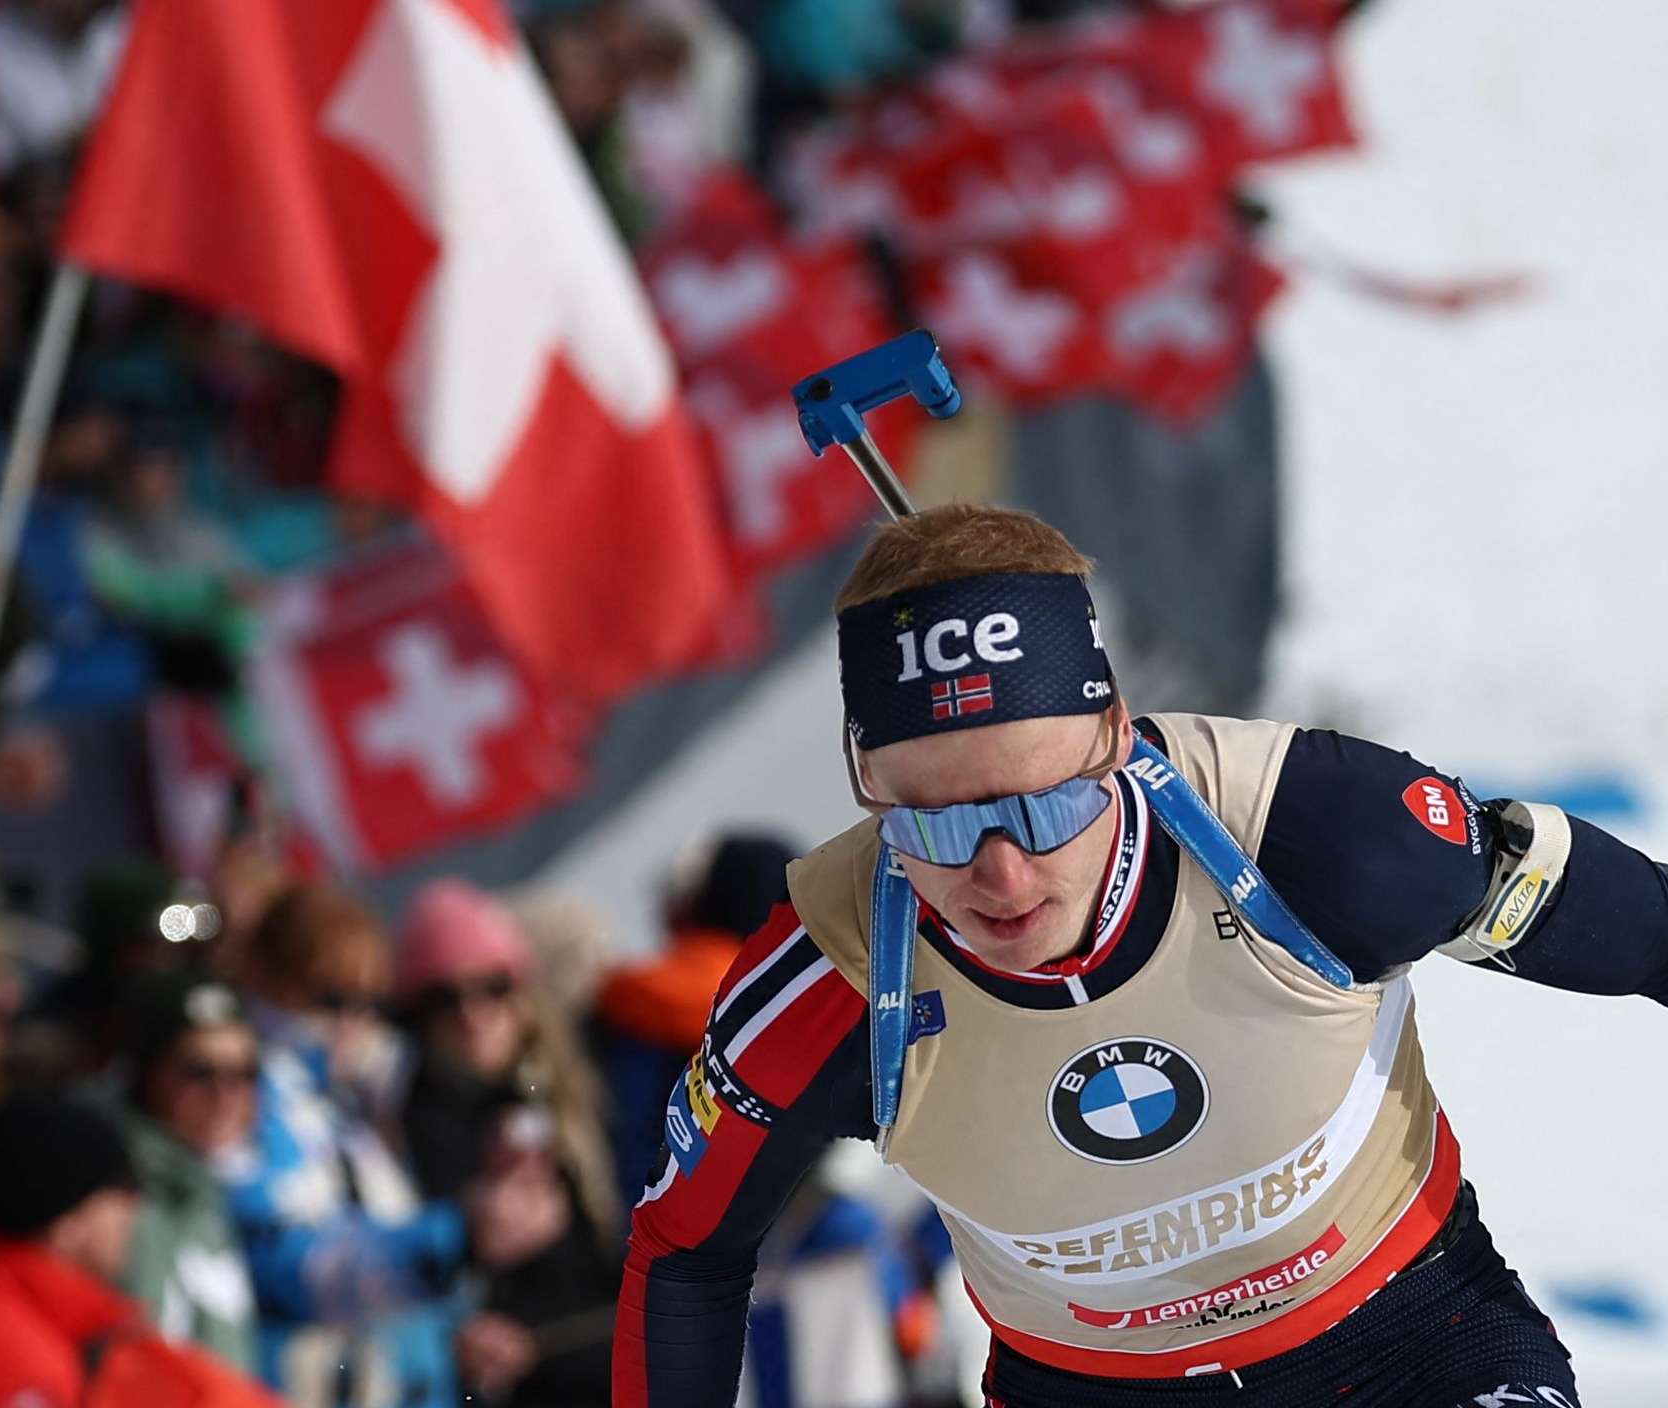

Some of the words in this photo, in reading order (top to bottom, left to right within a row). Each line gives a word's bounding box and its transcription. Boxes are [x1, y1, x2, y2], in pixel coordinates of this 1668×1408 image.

[895, 611, 1024, 683] ice
[1421, 785, 1450, 826] BM
[1061, 1045, 1172, 1093] BMW
[1012, 1134, 1328, 1256] DEFENDING
[1144, 1246, 1330, 1326] Lenzerheide
